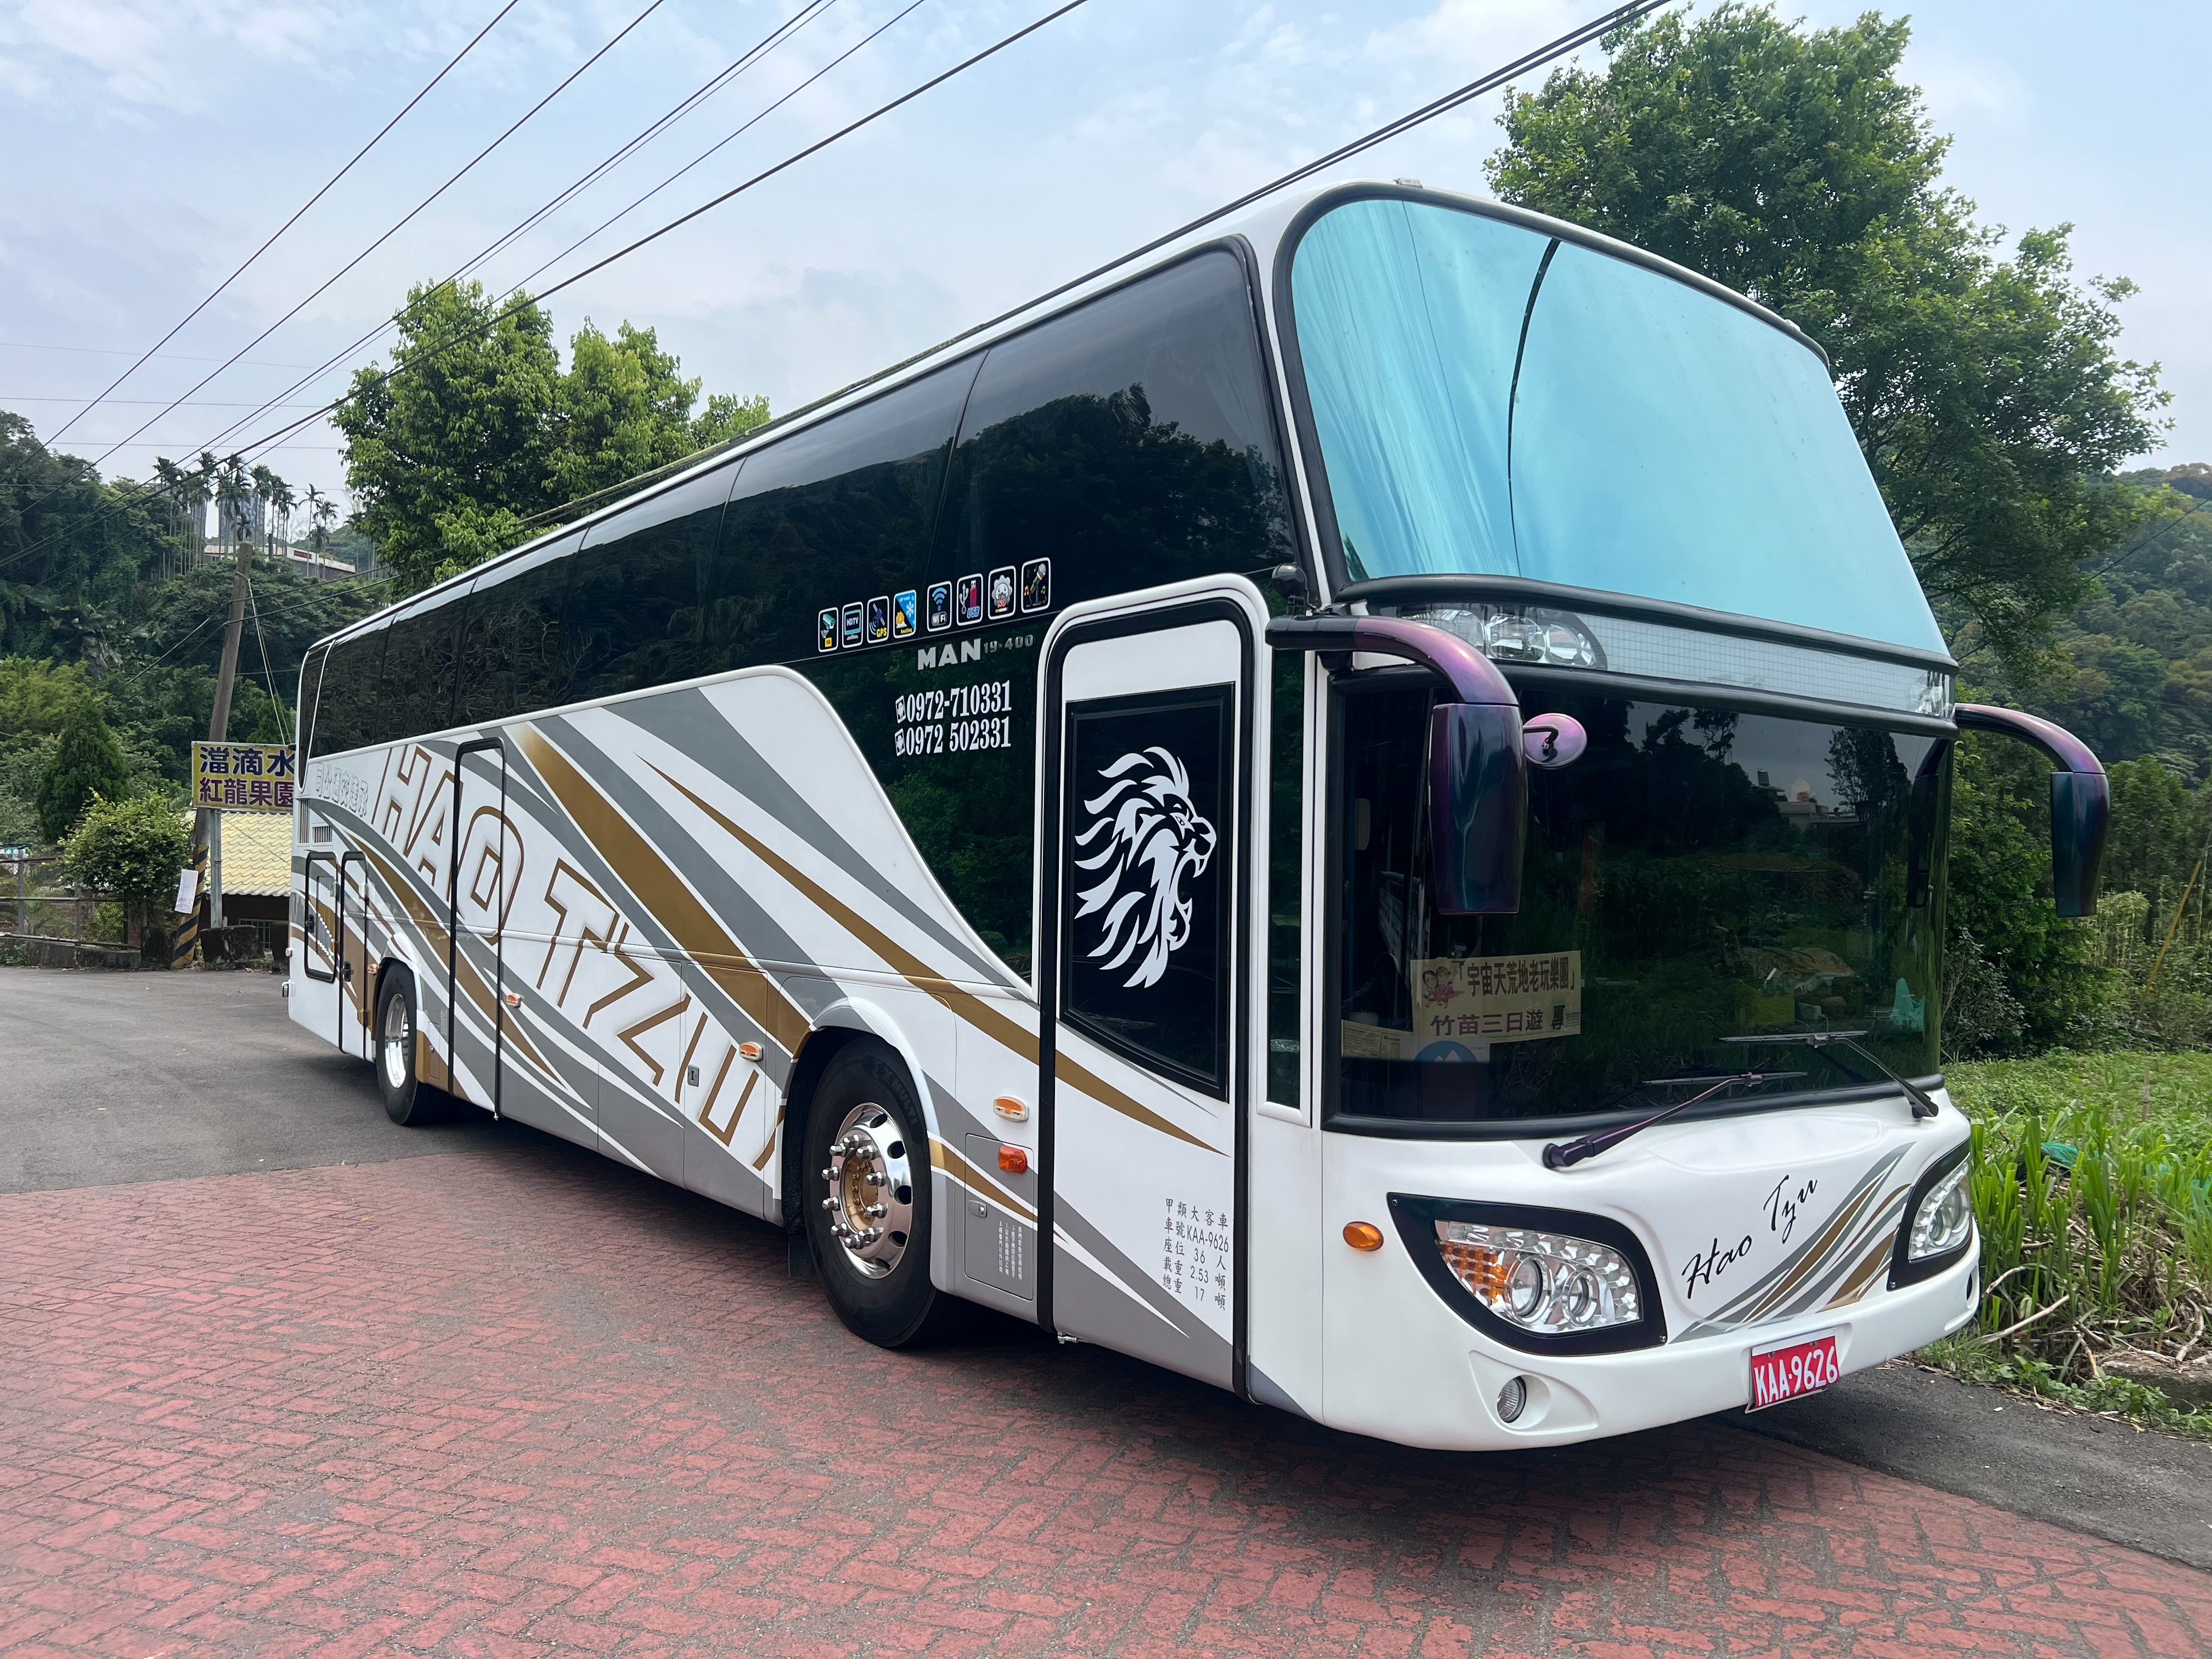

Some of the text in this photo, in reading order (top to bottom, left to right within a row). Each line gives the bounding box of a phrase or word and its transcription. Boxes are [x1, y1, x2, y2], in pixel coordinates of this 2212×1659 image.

[847, 617, 859, 627] HDTV
[967, 607, 980, 619] USB
[876, 628, 887, 638] GPS
[918, 639, 981, 670] MAN
[907, 680, 1012, 722] 0972-710331
[906, 716, 1011, 755] 0972 502331
[199, 777, 294, 807] 紅龍果園
[371, 744, 524, 945] HAO
[1166, 1198, 1228, 1231] 甲類大客車
[1194, 1248, 1205, 1263] 36
[1681, 1235, 1752, 1299] Hao
[1190, 1266, 1209, 1283] 2.53
